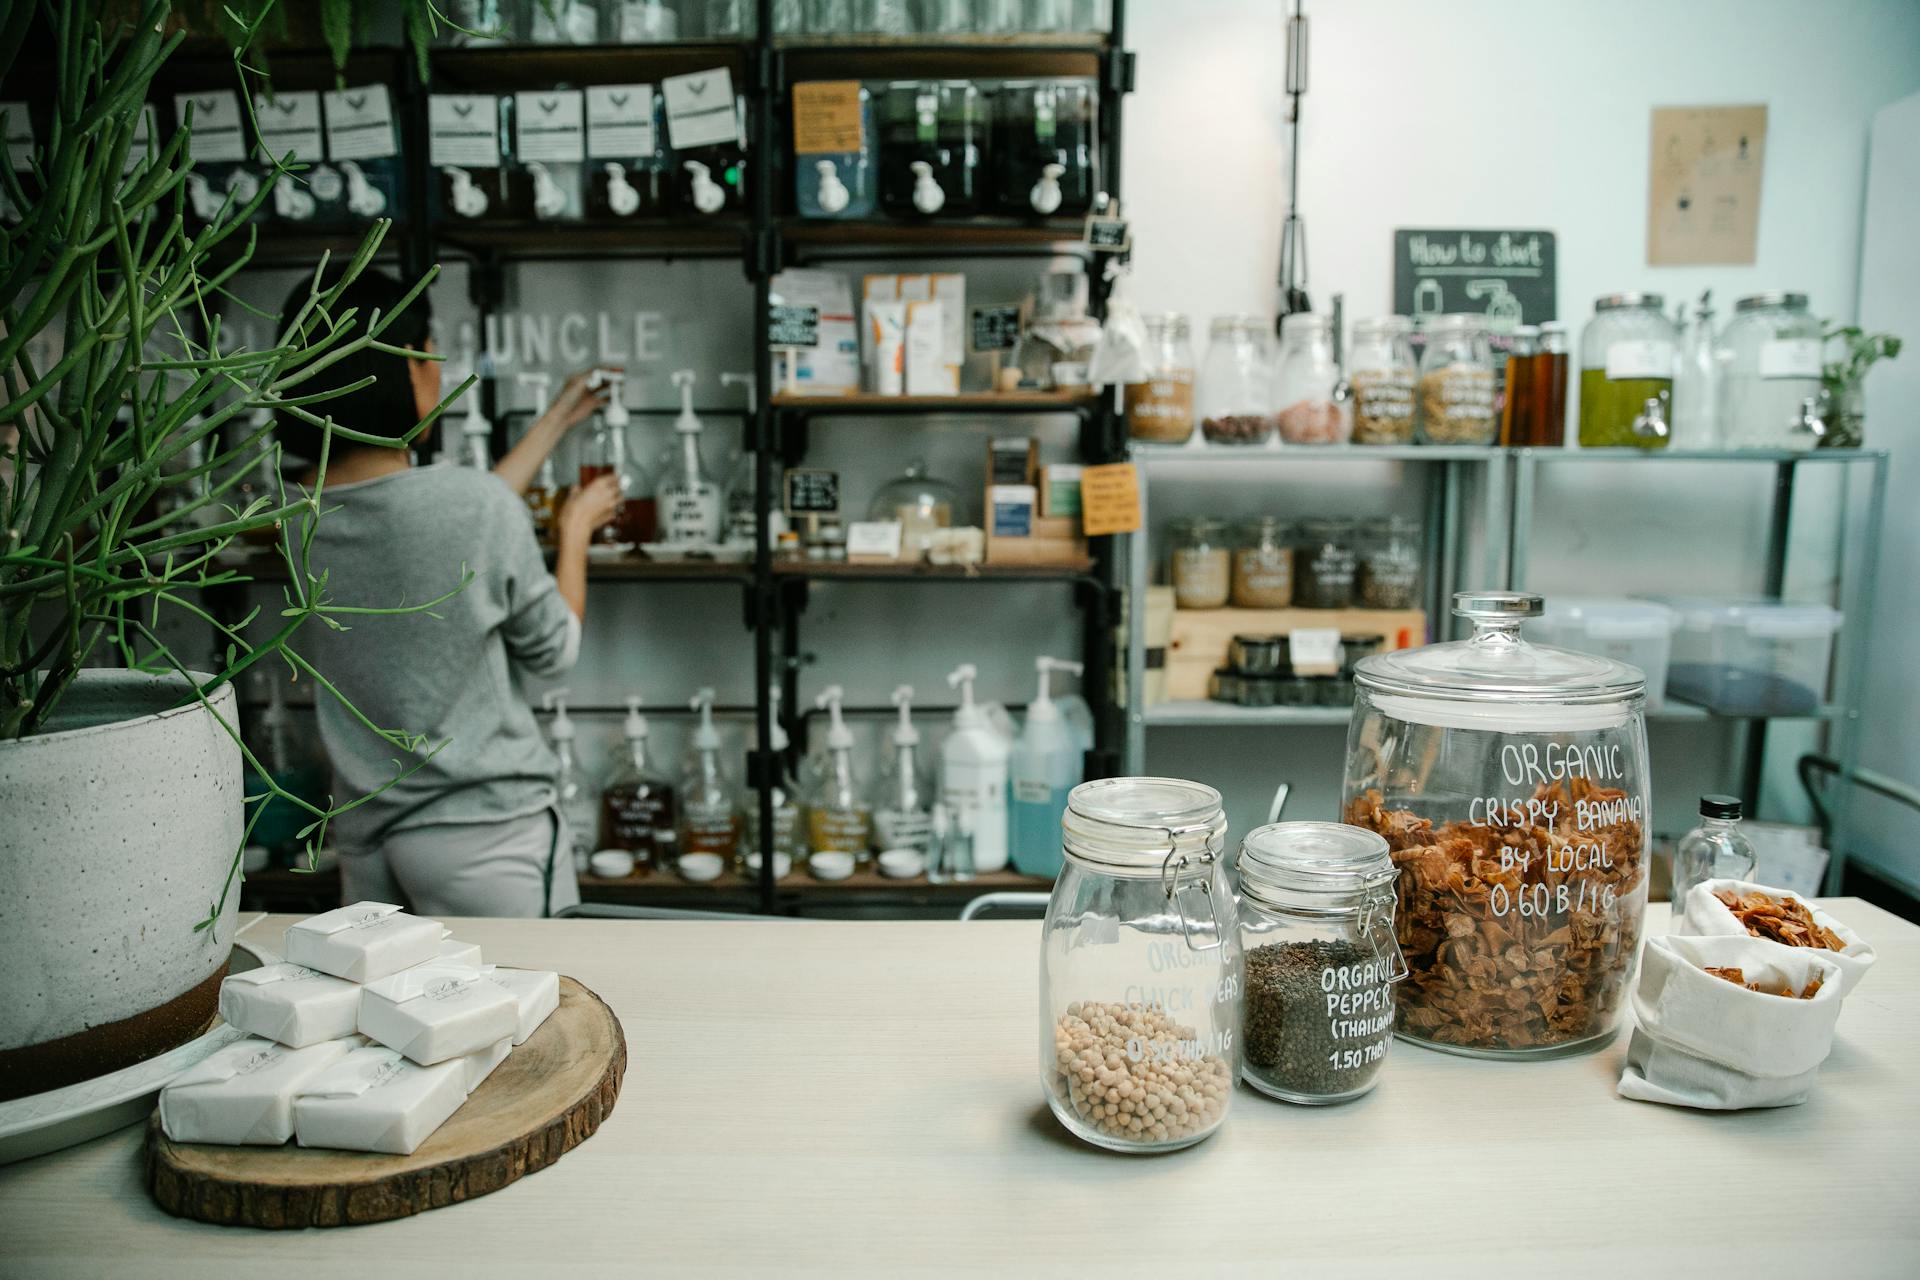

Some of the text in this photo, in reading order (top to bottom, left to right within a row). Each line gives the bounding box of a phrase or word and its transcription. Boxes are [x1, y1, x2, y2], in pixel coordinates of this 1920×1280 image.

[1460, 232, 1487, 263] to
[485, 309, 663, 364] UNCLE
[1501, 742, 1623, 786] ORGANIC
[1468, 795, 1642, 834] CRISPY BANANA
[1501, 841, 1613, 873] BY LOCAL
[1146, 940, 1232, 973] ORGAIC
[1321, 952, 1396, 993] ORGANIC
[1207, 974, 1239, 1004] EAS
[1326, 983, 1391, 1018] PEPPER
